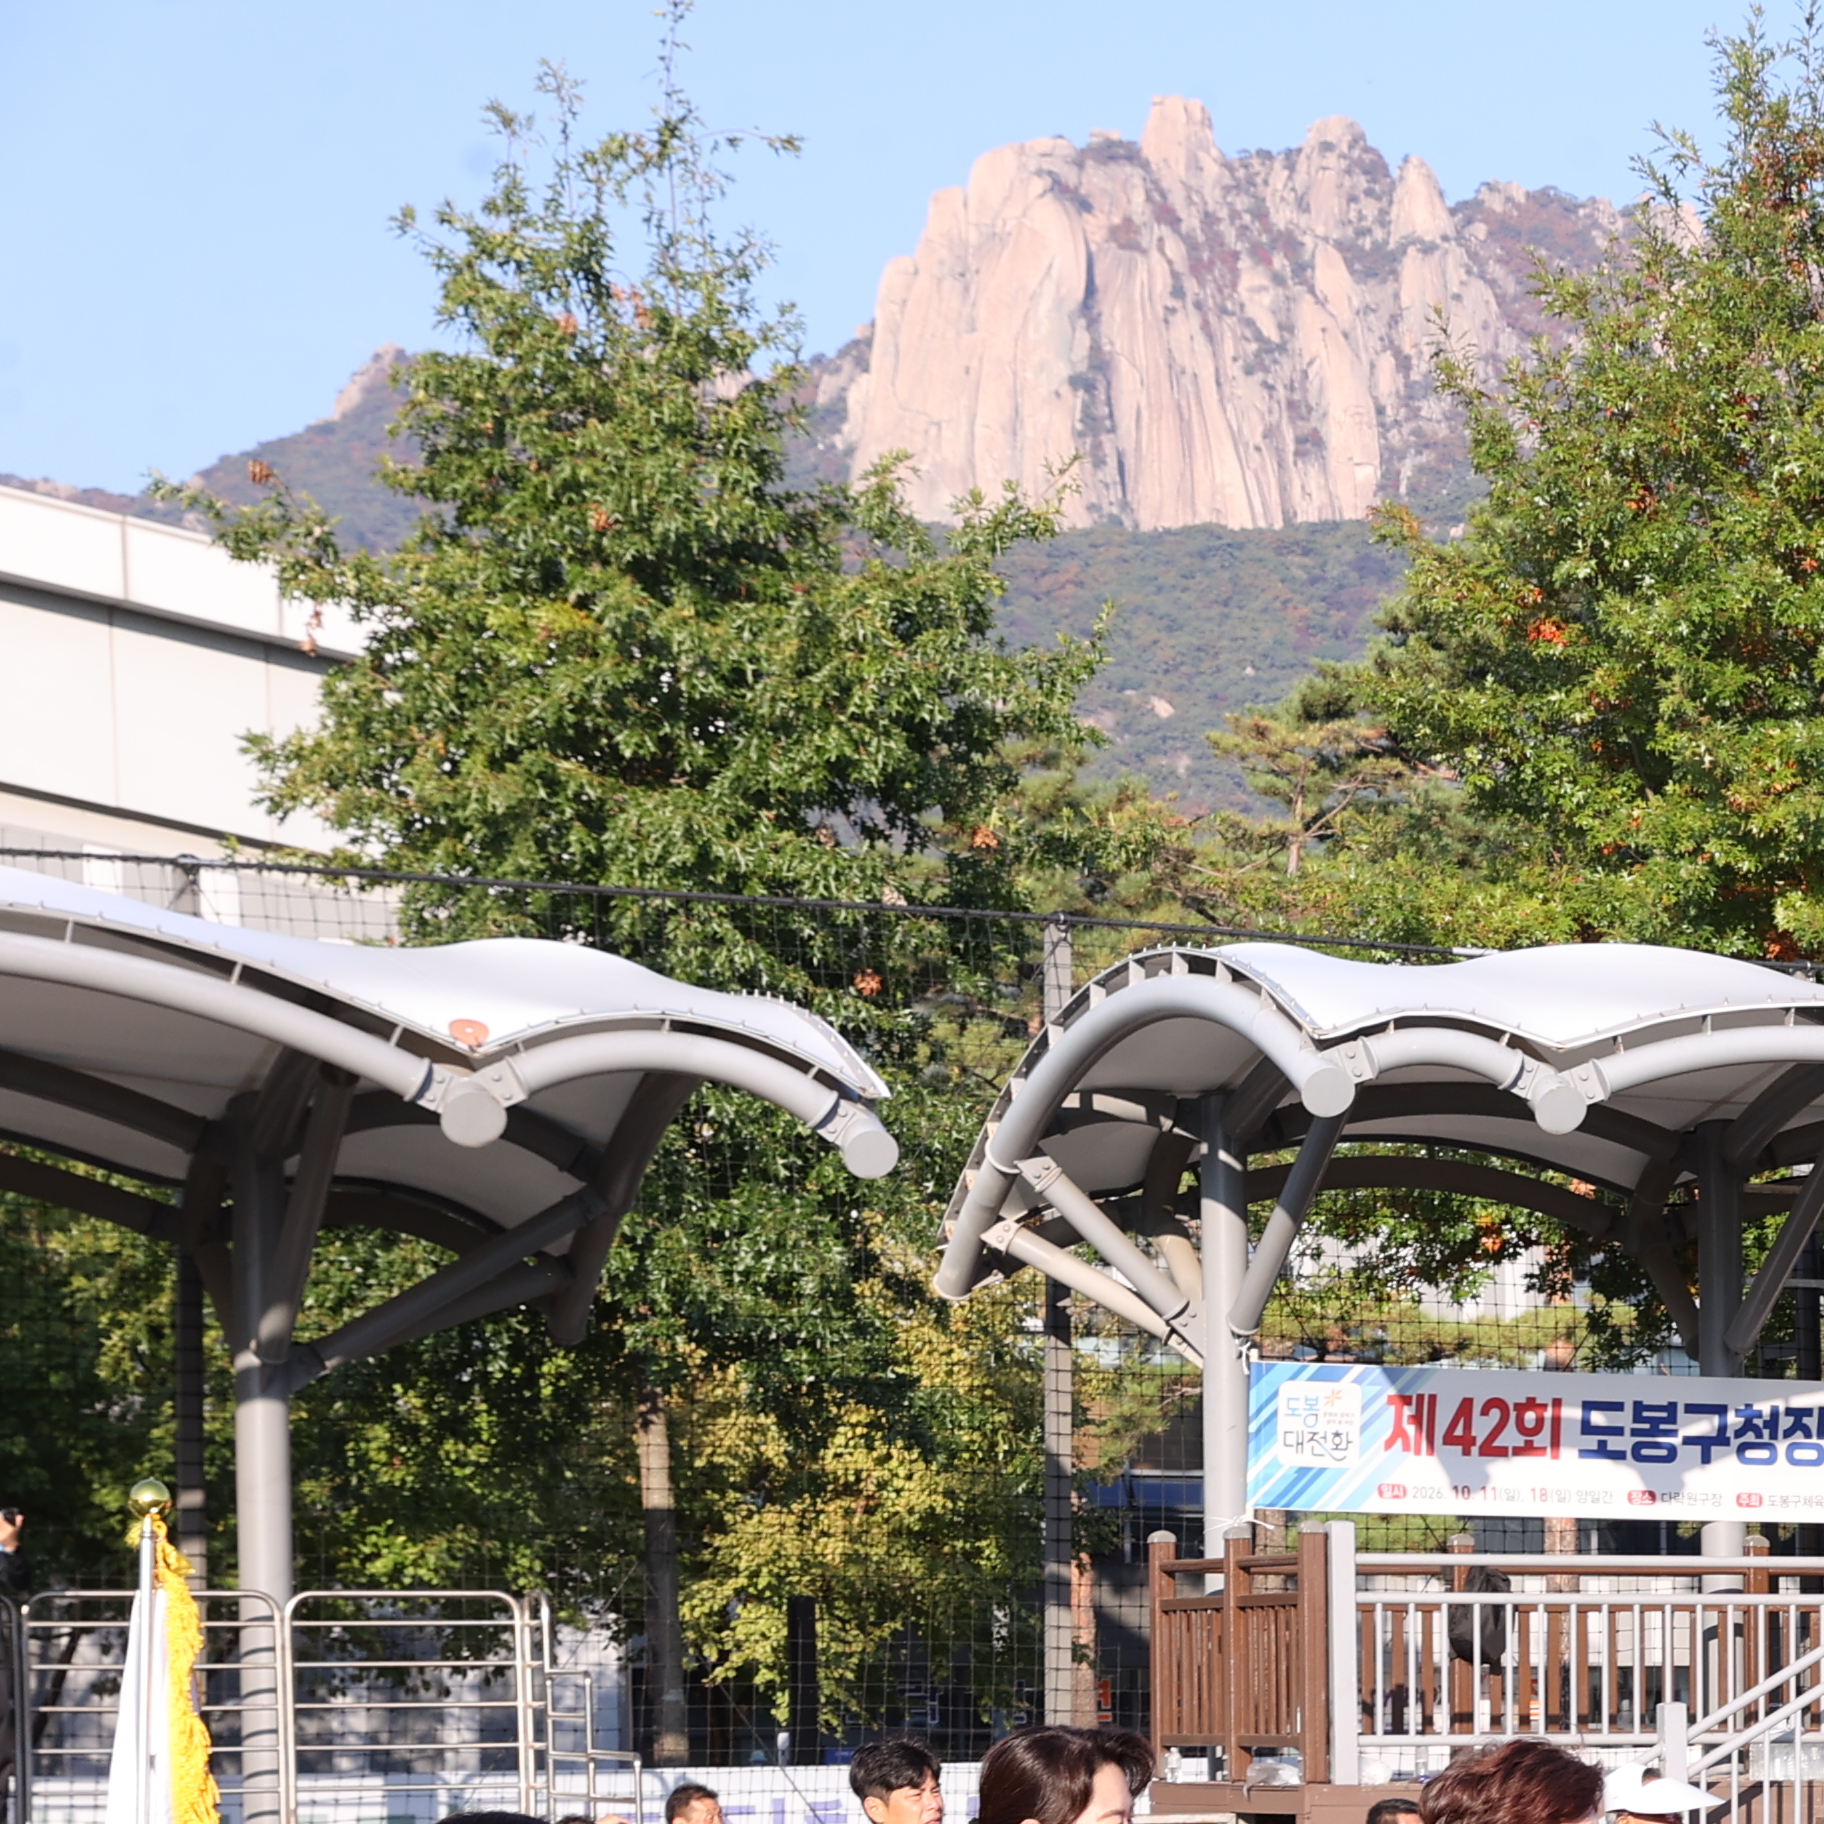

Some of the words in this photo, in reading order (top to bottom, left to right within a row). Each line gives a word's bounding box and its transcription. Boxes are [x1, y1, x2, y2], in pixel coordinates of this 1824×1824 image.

[1284, 1396, 1320, 1428] 도봉
[1384, 1393, 1563, 1460] 제42회
[1283, 1429, 1354, 1462] 대전환
[1380, 1484, 1405, 1499] 일시
[1412, 1486, 1447, 1500] 2026.
[1453, 1485, 1475, 1500] 10.
[1531, 1487, 1571, 1504] 18(일)
[1576, 1488, 1613, 1504] 양일간
[1630, 1491, 1654, 1505] 장소
[1660, 1491, 1723, 1507] 다락원구장
